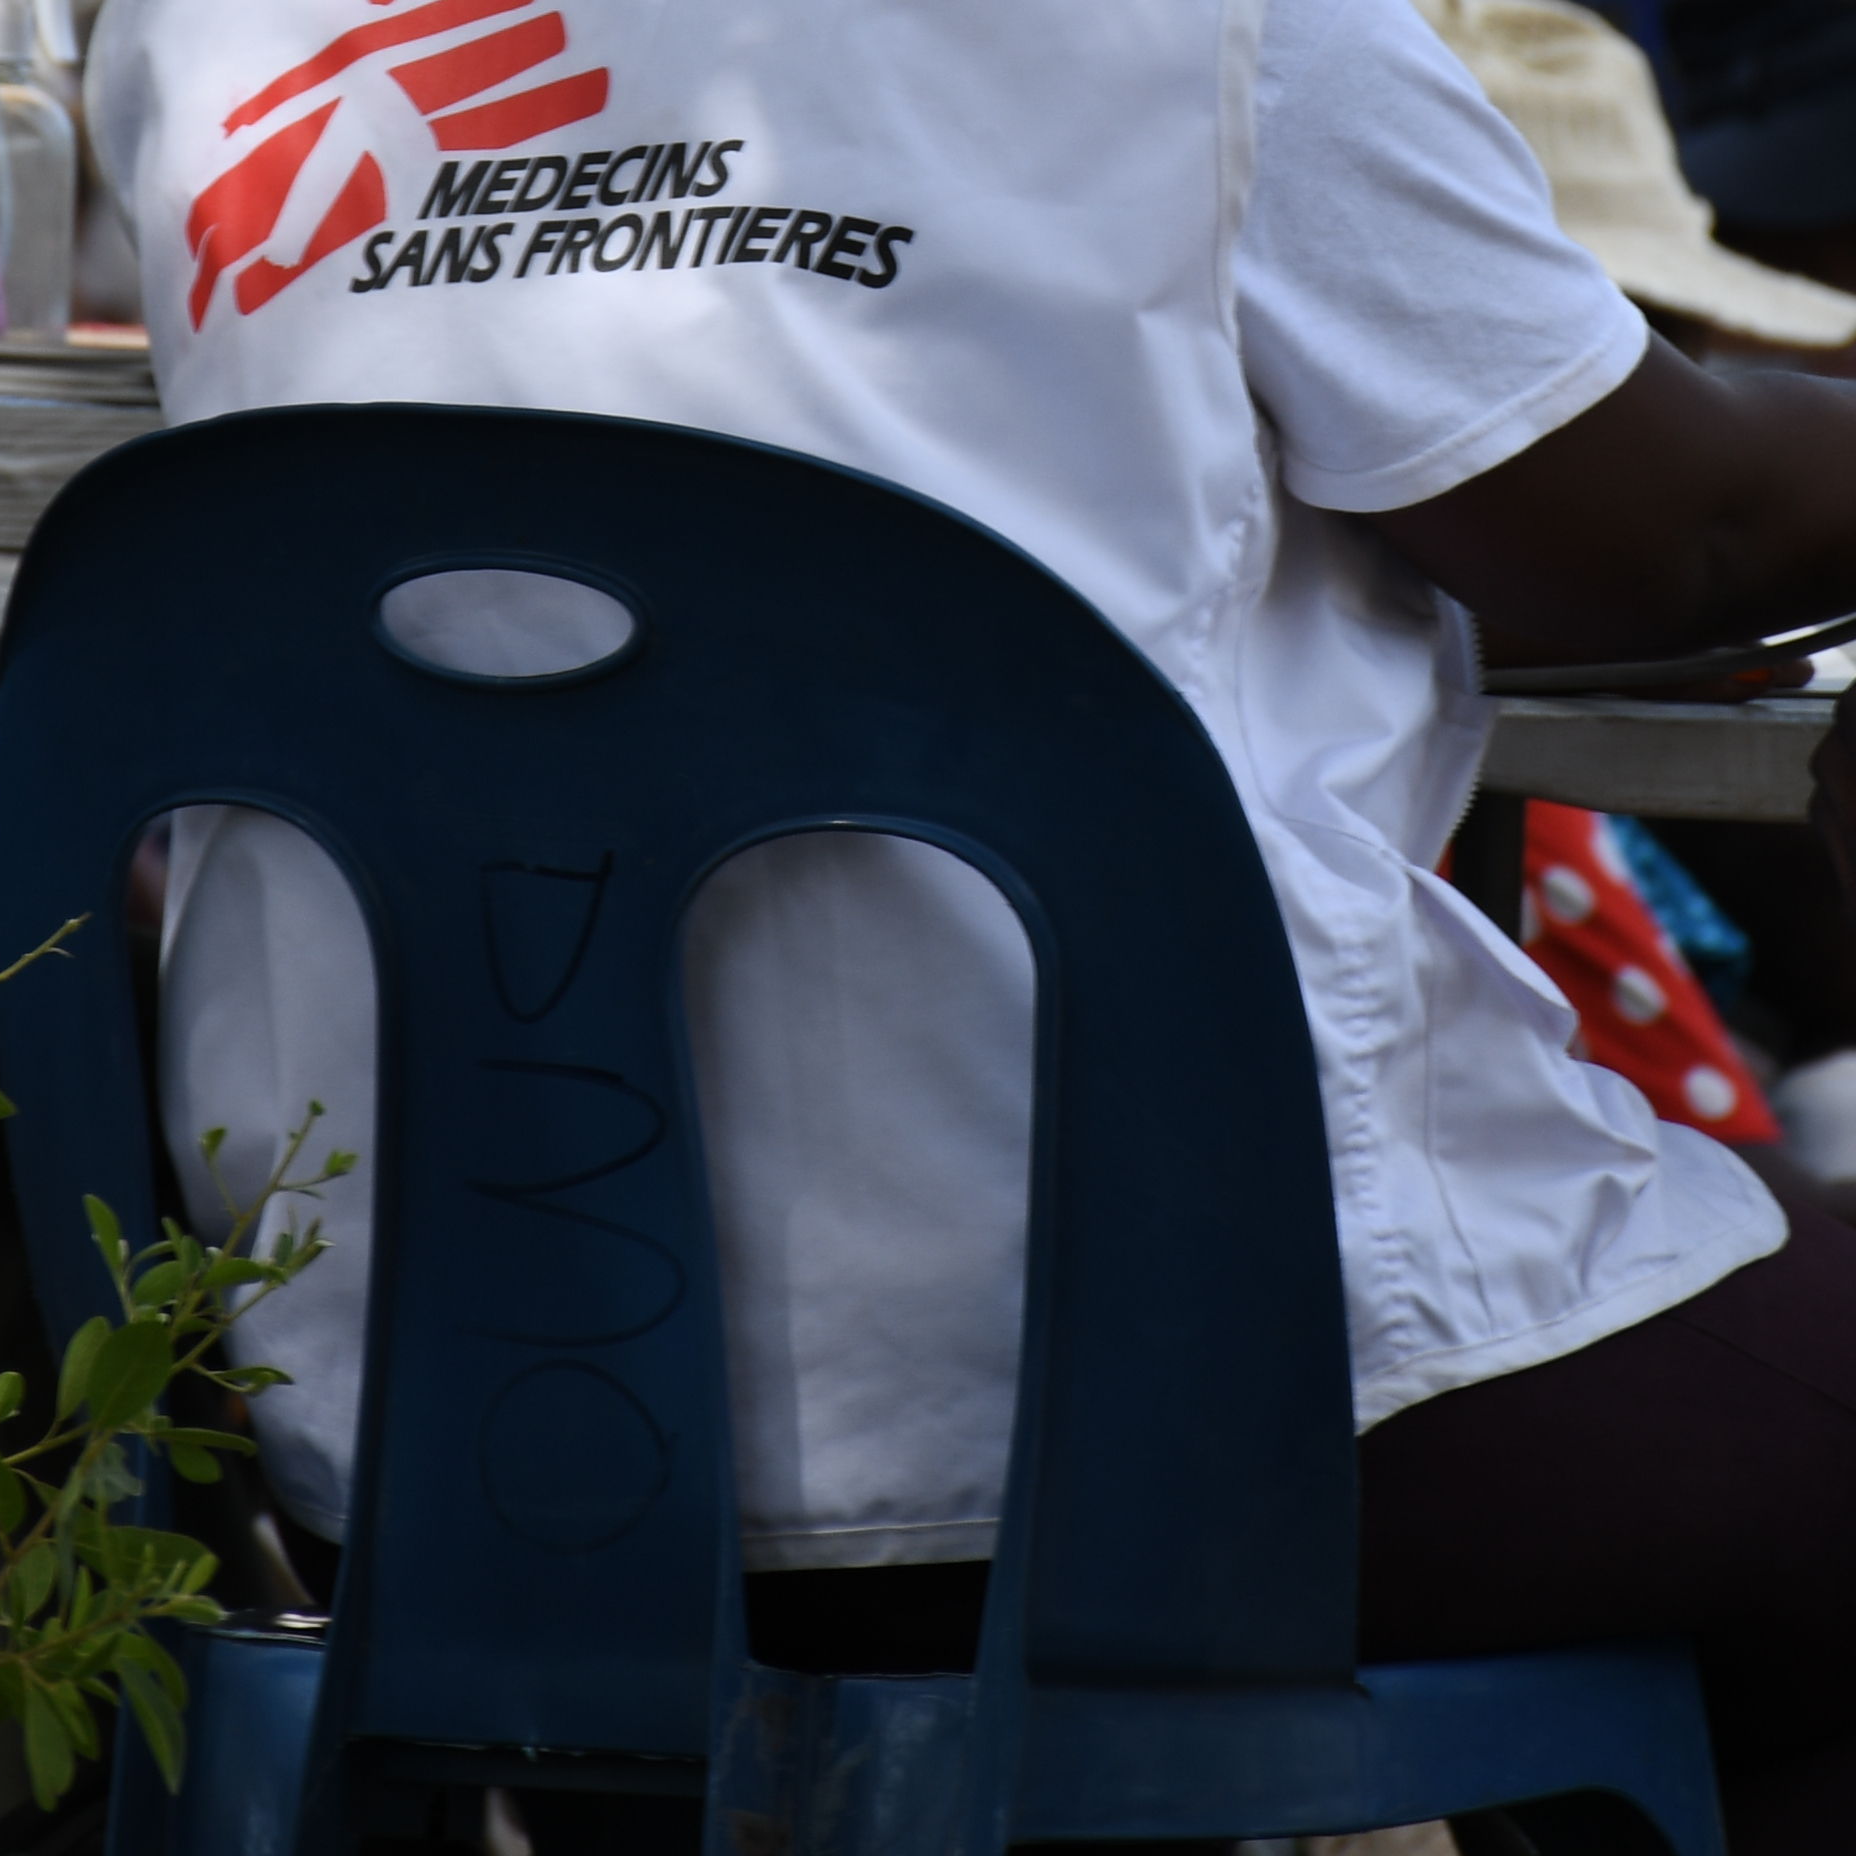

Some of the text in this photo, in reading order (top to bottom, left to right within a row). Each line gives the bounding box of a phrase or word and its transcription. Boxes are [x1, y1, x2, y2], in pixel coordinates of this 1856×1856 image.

[416, 140, 744, 219] MEDECINS
[350, 206, 913, 293] SANS FRONTIERES
